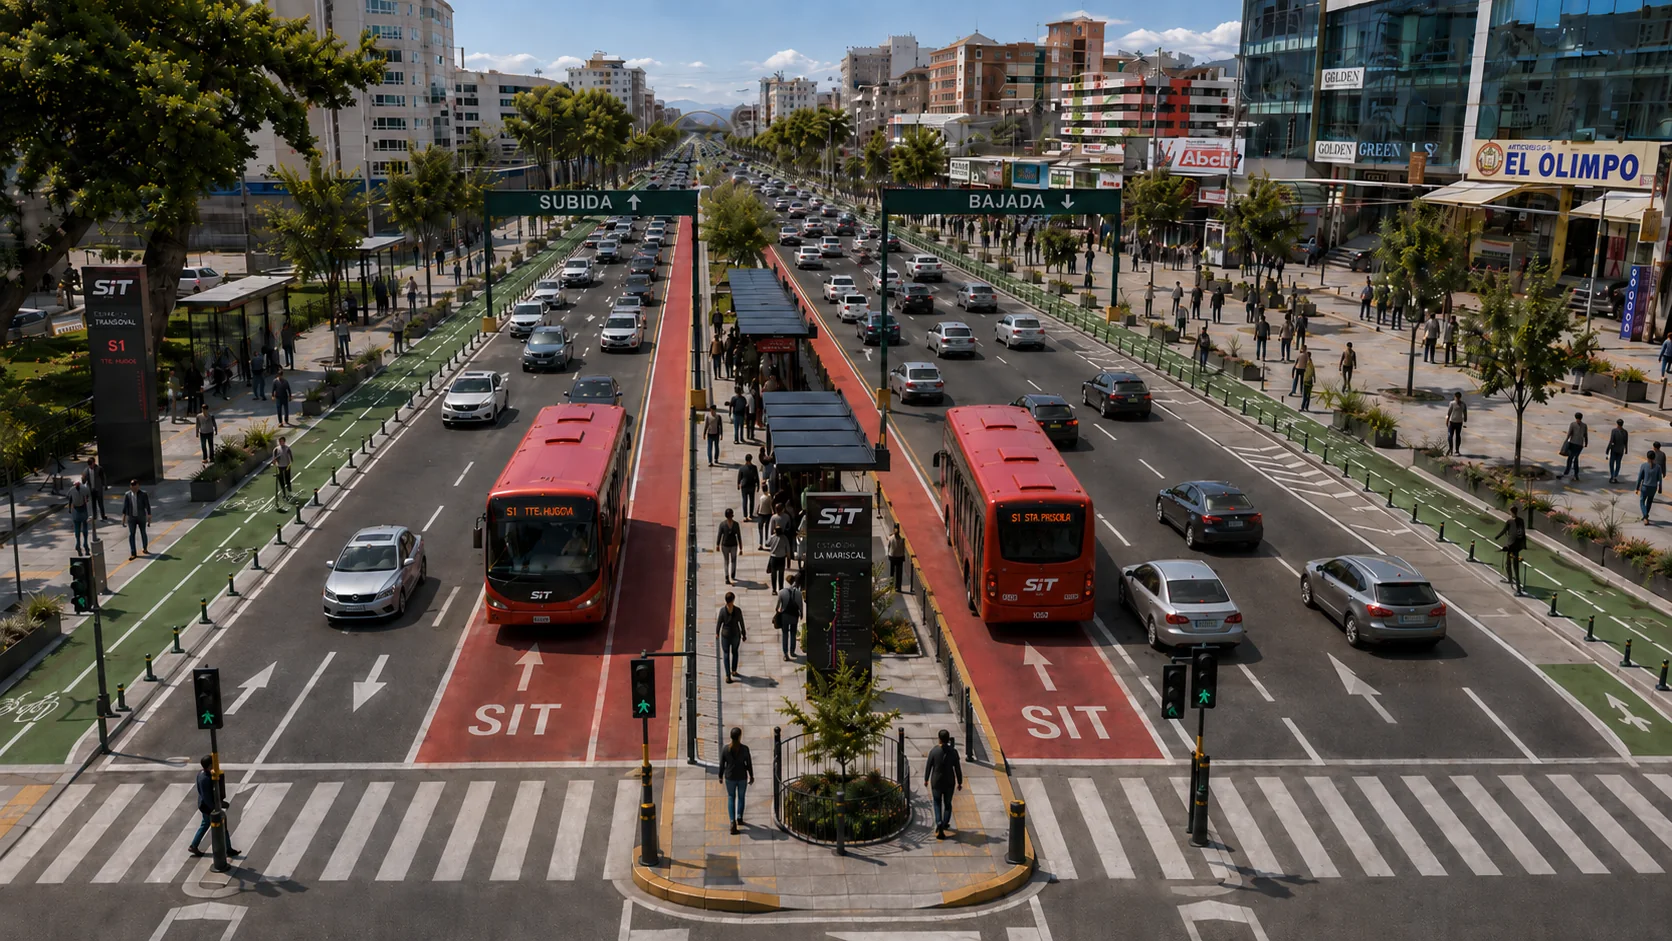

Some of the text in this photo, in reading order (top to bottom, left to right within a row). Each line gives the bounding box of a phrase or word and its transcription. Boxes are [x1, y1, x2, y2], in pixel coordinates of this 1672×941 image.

[1358, 142, 1402, 157] GREEN
[1504, 151, 1530, 176] EL
[1538, 152, 1639, 181] OLIMPO
[539, 194, 613, 210] SUBIDA
[969, 194, 1045, 209] BAJADA
[107, 339, 125, 352] S1
[813, 551, 867, 560] LA MARISCAL
[468, 703, 562, 736] SIT
[1021, 705, 1111, 740] SIT
